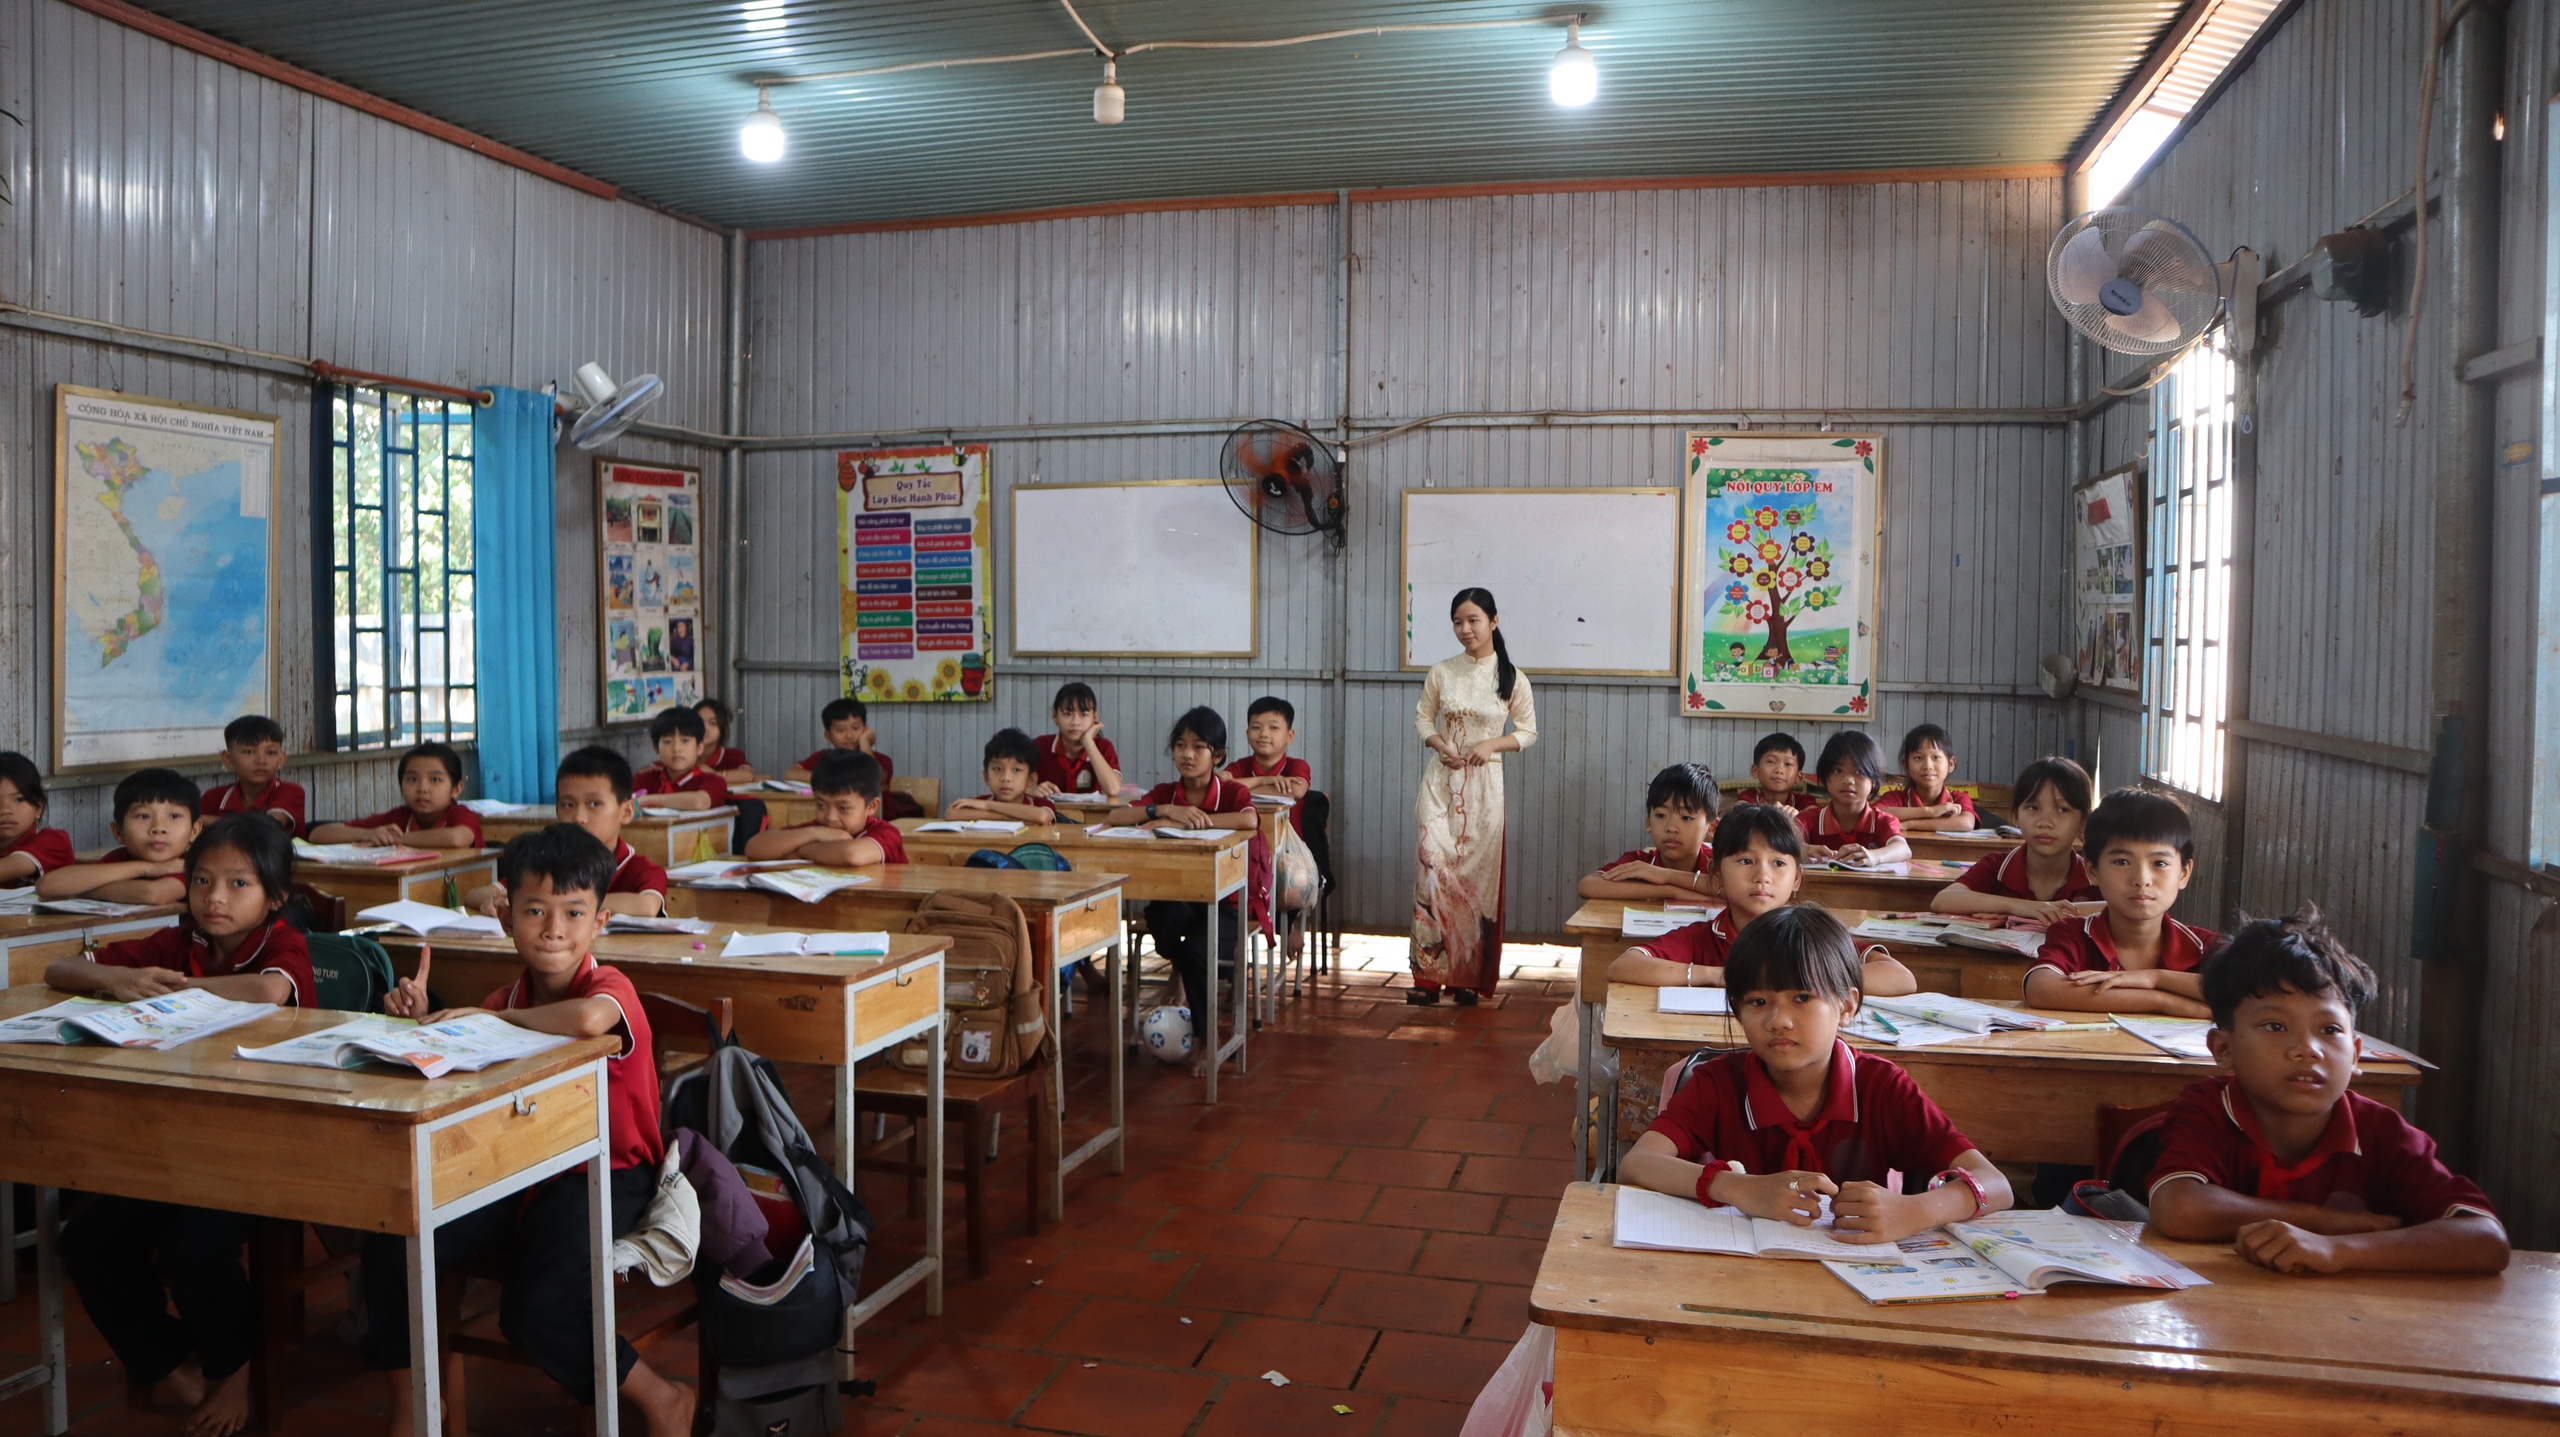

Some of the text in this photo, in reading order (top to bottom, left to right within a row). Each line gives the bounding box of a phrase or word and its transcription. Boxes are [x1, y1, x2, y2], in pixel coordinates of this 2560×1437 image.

[78, 402, 107, 415] CỘNG
[244, 428, 264, 438] NAM
[896, 480, 913, 490] Quy
[1726, 479, 1833, 494] NỘI QUY LỚP EM
[872, 494, 888, 505] Lớp
[891, 494, 907, 503] Học
[935, 490, 957, 501] Phúc
